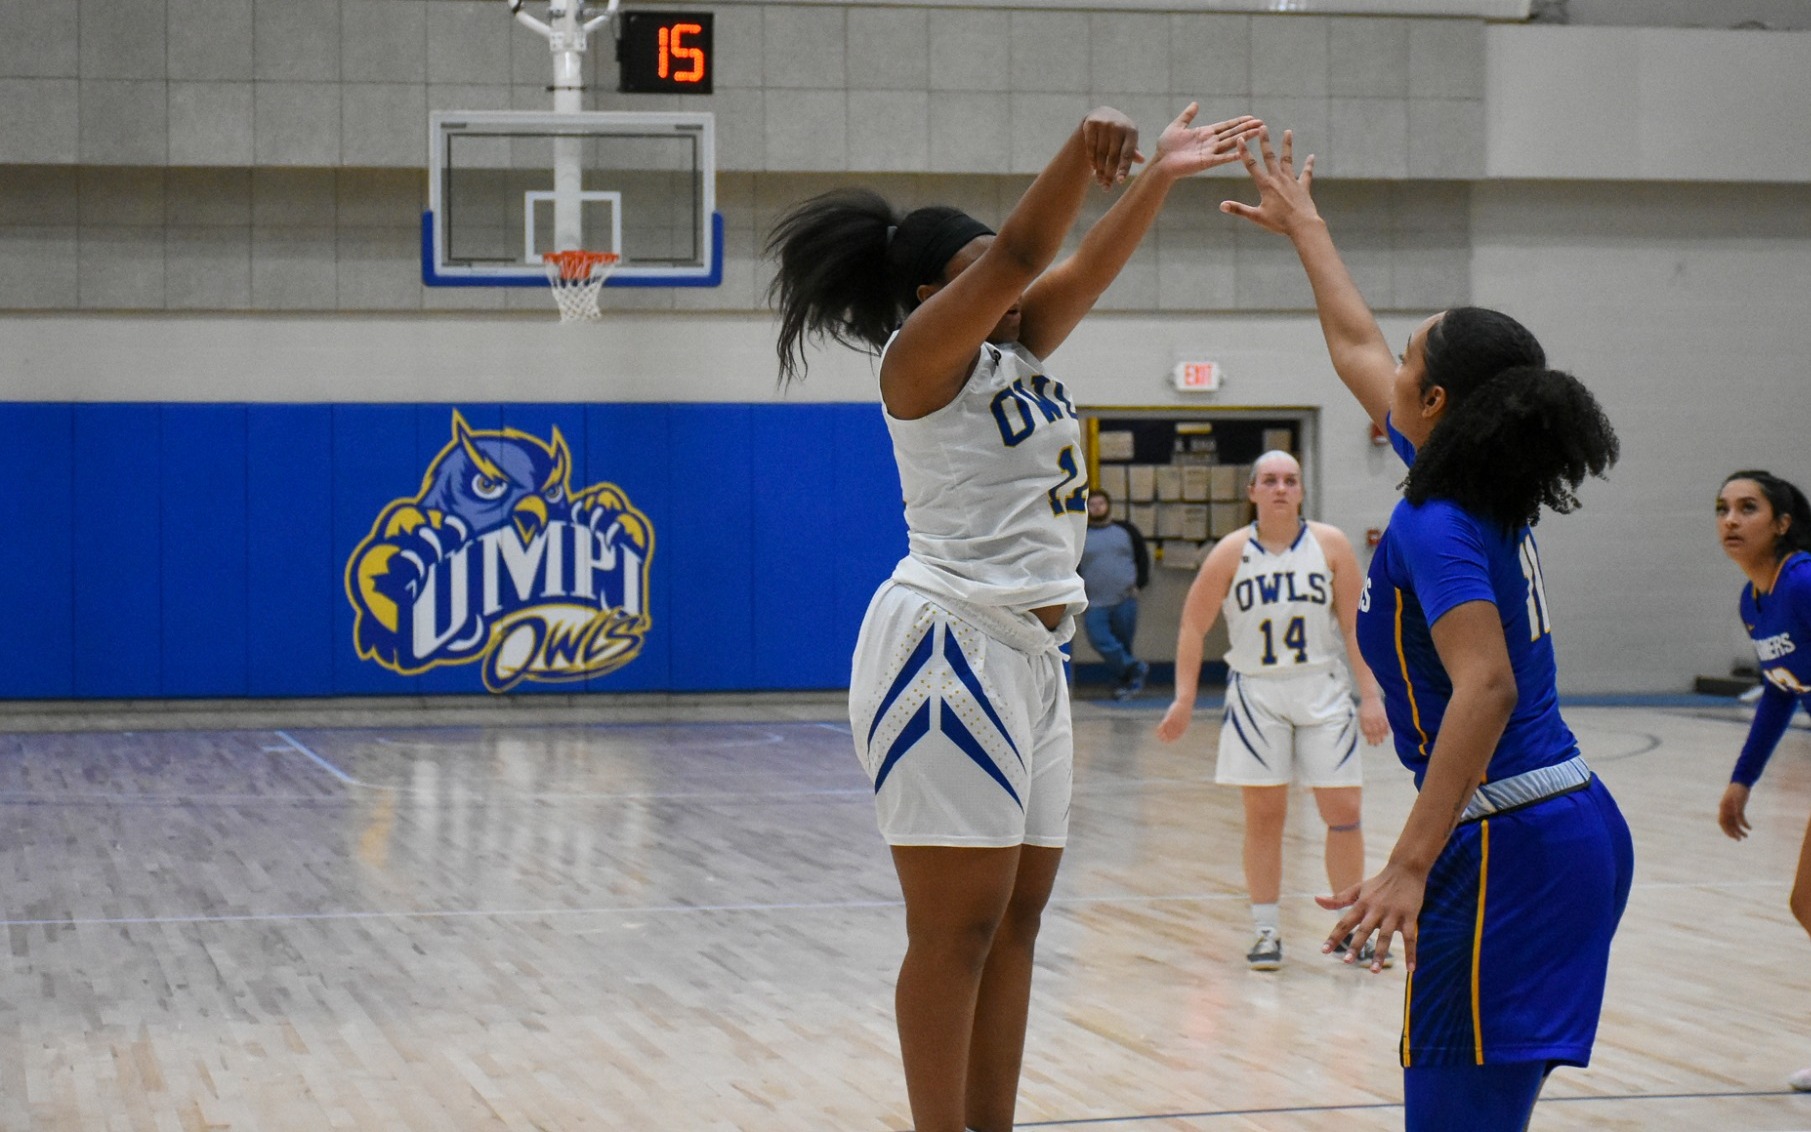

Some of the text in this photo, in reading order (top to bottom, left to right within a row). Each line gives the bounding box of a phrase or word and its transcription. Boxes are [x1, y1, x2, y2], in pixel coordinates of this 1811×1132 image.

[658, 23, 704, 82] 15
[1184, 362, 1213, 386] EXIT
[412, 519, 643, 659] UMPI
[1235, 571, 1327, 612] OWLS
[1258, 615, 1308, 666] 14
